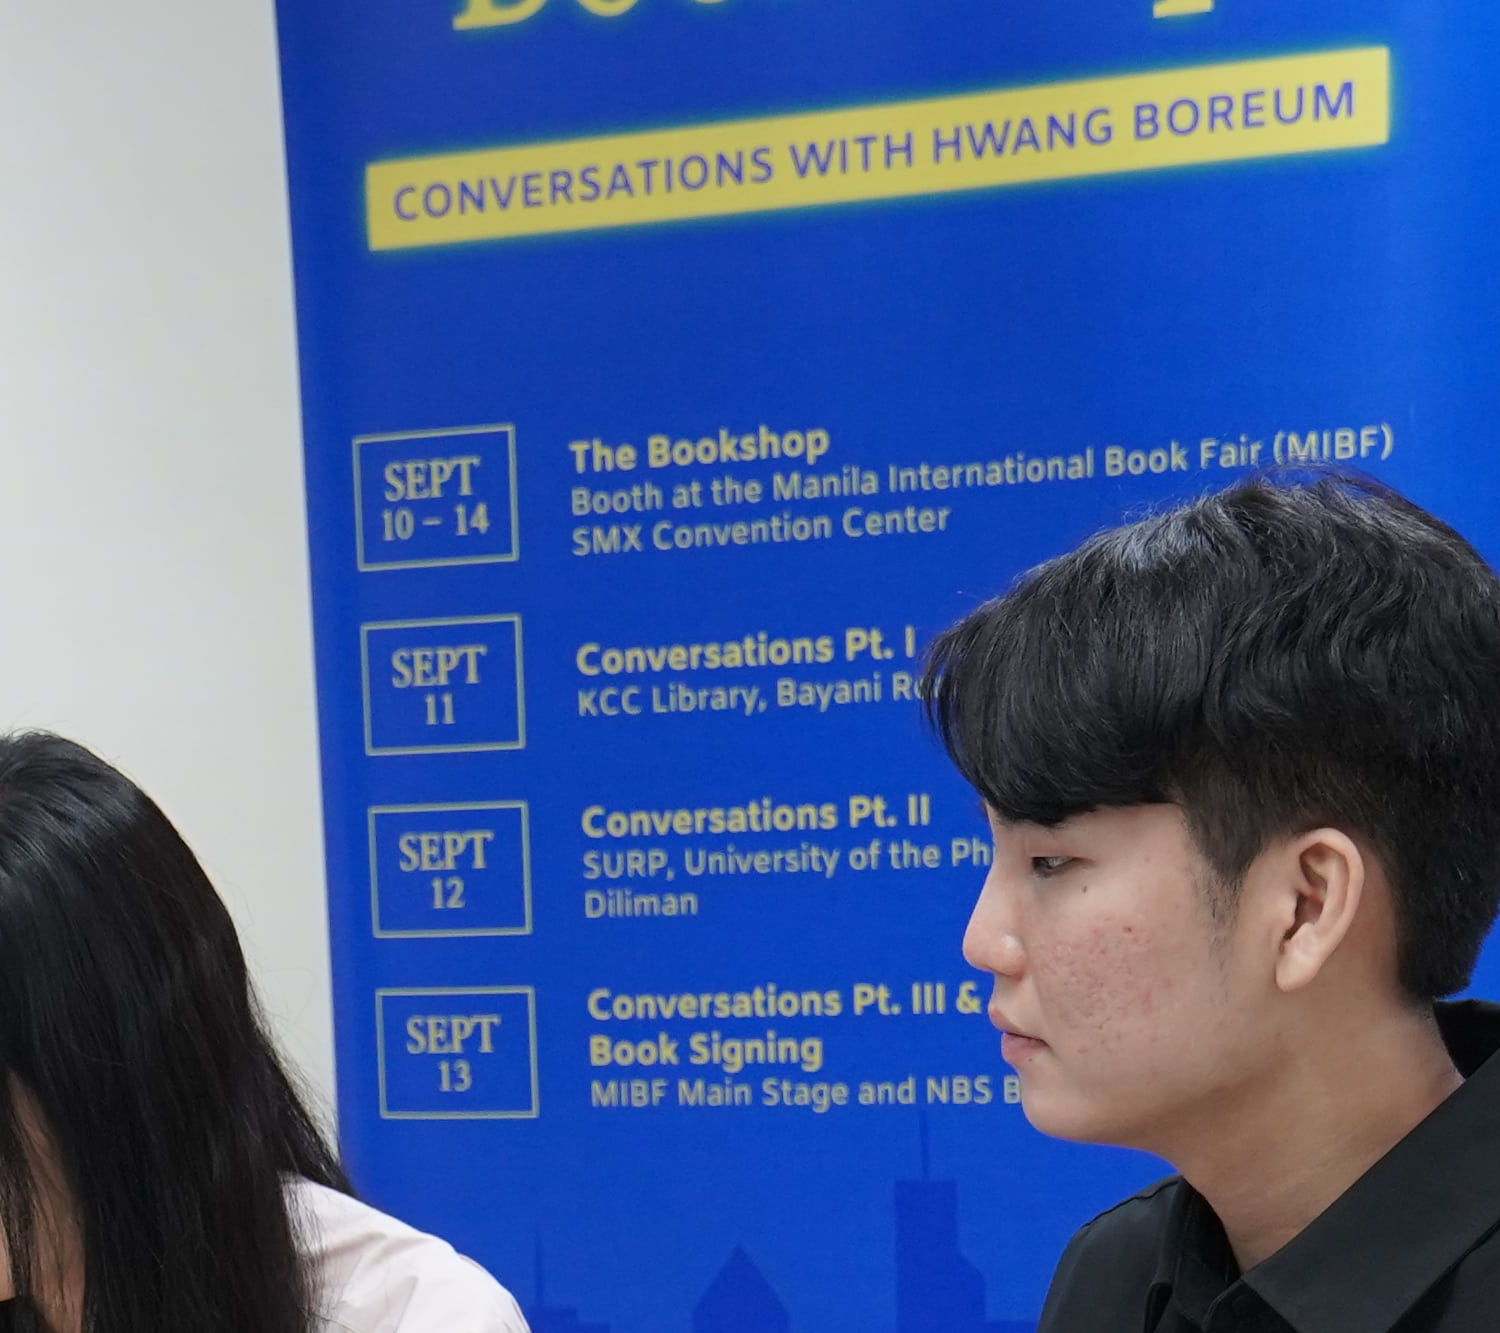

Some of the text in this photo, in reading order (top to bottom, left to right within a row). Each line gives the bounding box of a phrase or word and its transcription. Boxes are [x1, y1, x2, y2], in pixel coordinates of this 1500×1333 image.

[391, 78, 1356, 223] CONVERSATIONS WITH HWANG BOREUM
[568, 425, 830, 474] The Bookshop
[571, 422, 1394, 517] Booth at the Manila International Book Fair (MIBF)
[384, 456, 481, 502] SEPT
[381, 507, 415, 542] 10
[455, 502, 490, 536] 14
[572, 505, 951, 557] SMX Convention Center
[391, 644, 487, 689] SEPT
[575, 625, 916, 676] Conversations Pt. I
[424, 692, 455, 726] 11
[577, 685, 642, 717] KCC
[651, 683, 767, 716] Library,
[776, 672, 882, 713] Bayani
[581, 793, 930, 839] Conversations Pt. II
[398, 830, 495, 873] SEPT
[582, 848, 675, 881] SURP,
[684, 842, 841, 879] University
[848, 838, 882, 871] of
[887, 839, 941, 870] the
[431, 876, 465, 910] 12
[584, 888, 699, 919] Diliman
[587, 981, 982, 1021] Conversations Pt. III &
[406, 1014, 502, 1055] SEPT
[589, 1029, 823, 1074] Book Signing
[439, 1059, 473, 1093] 13
[590, 1078, 668, 1108] MIBF
[677, 1077, 752, 1107] Main
[761, 1077, 850, 1114] Stage
[858, 1076, 916, 1106] and
[926, 1075, 993, 1105] NBS
